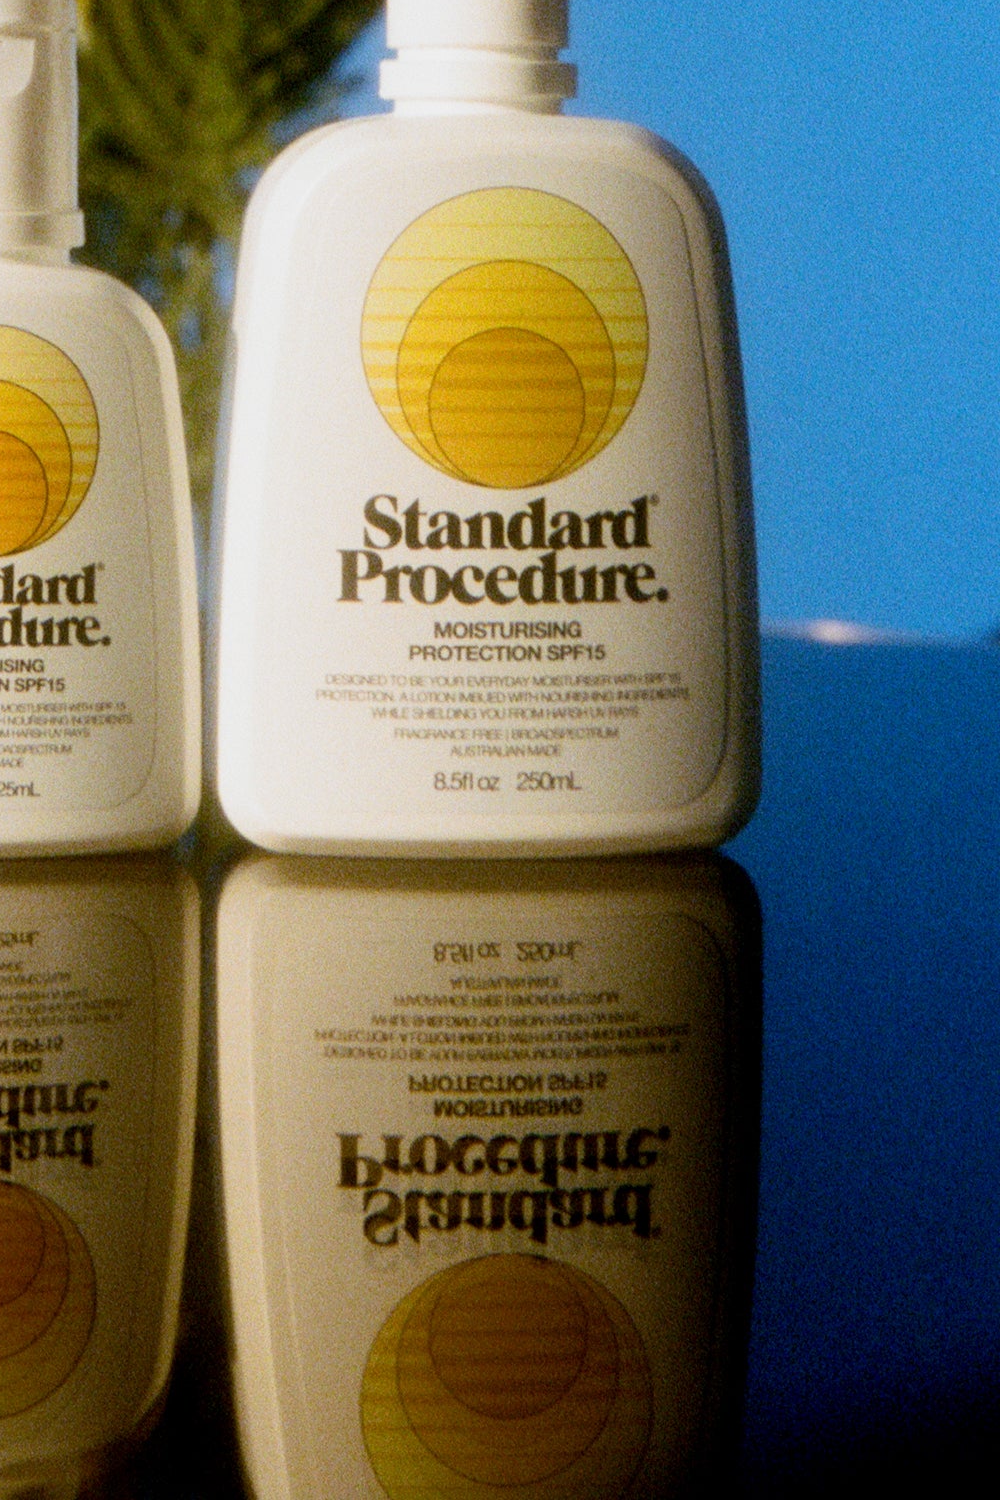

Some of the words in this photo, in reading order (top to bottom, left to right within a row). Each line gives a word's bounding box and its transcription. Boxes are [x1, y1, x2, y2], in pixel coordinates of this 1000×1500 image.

[336, 549, 670, 605] Procedure.
[434, 621, 582, 640] MOISTURISING
[409, 645, 541, 662] PROTECTION
[547, 645, 606, 663] SPF15
[14, 677, 65, 692] SPF15
[516, 771, 582, 791] 250mL
